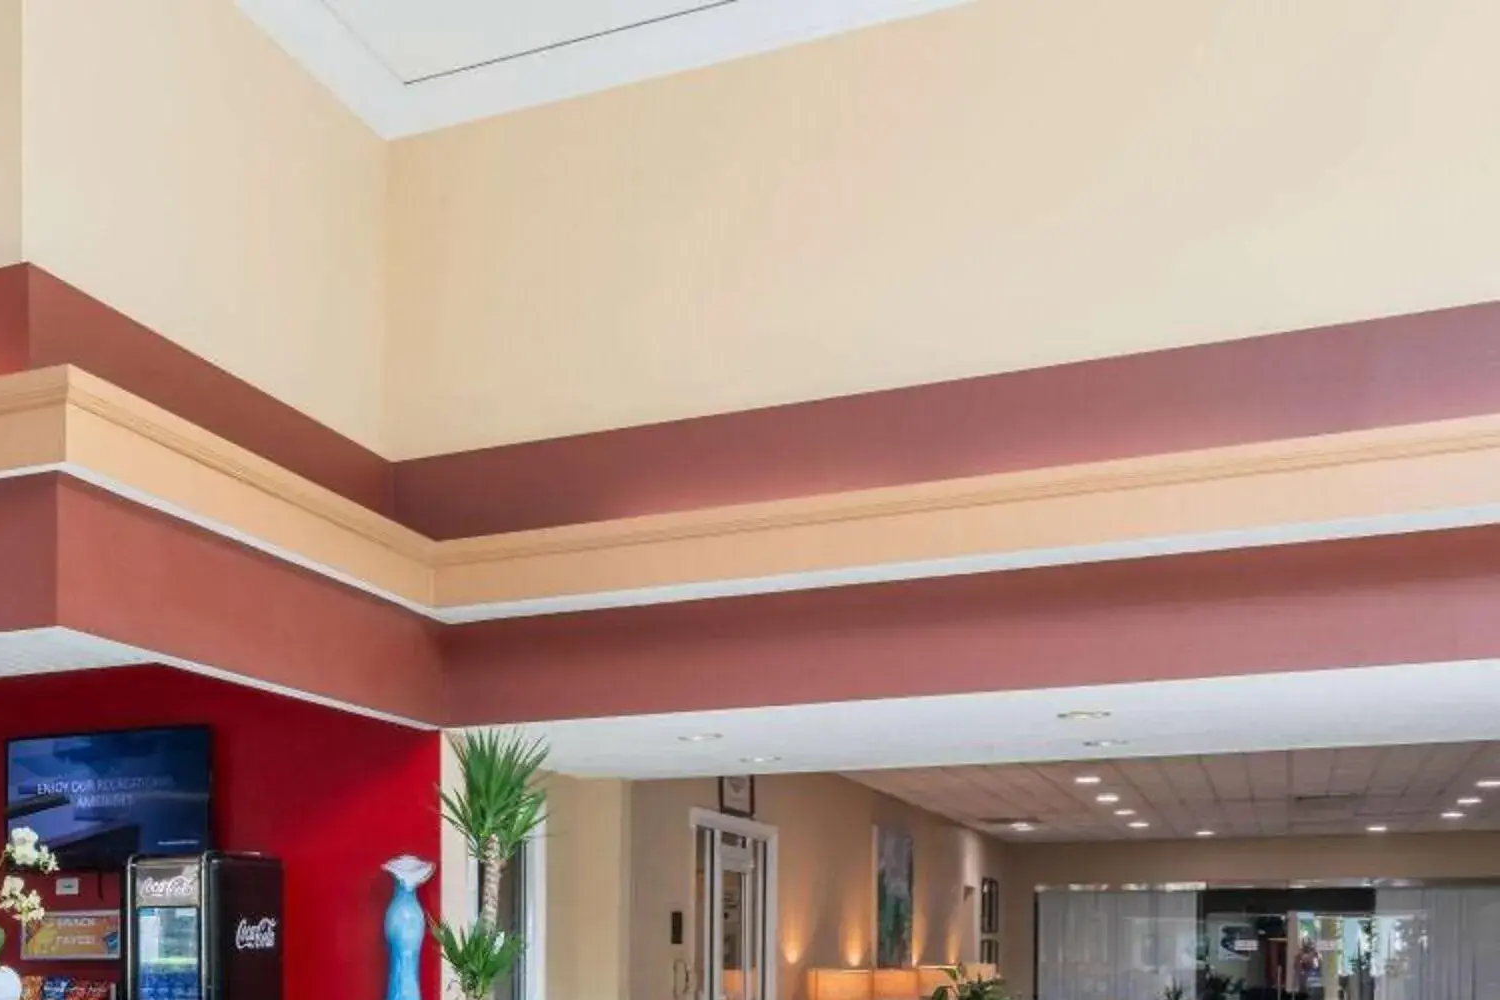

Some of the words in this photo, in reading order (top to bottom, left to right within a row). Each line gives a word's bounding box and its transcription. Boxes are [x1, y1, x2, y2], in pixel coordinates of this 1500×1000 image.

[37, 781, 69, 795] ENJOY
[71, 780, 95, 794] OUR
[235, 916, 277, 950] Coca-Cola
